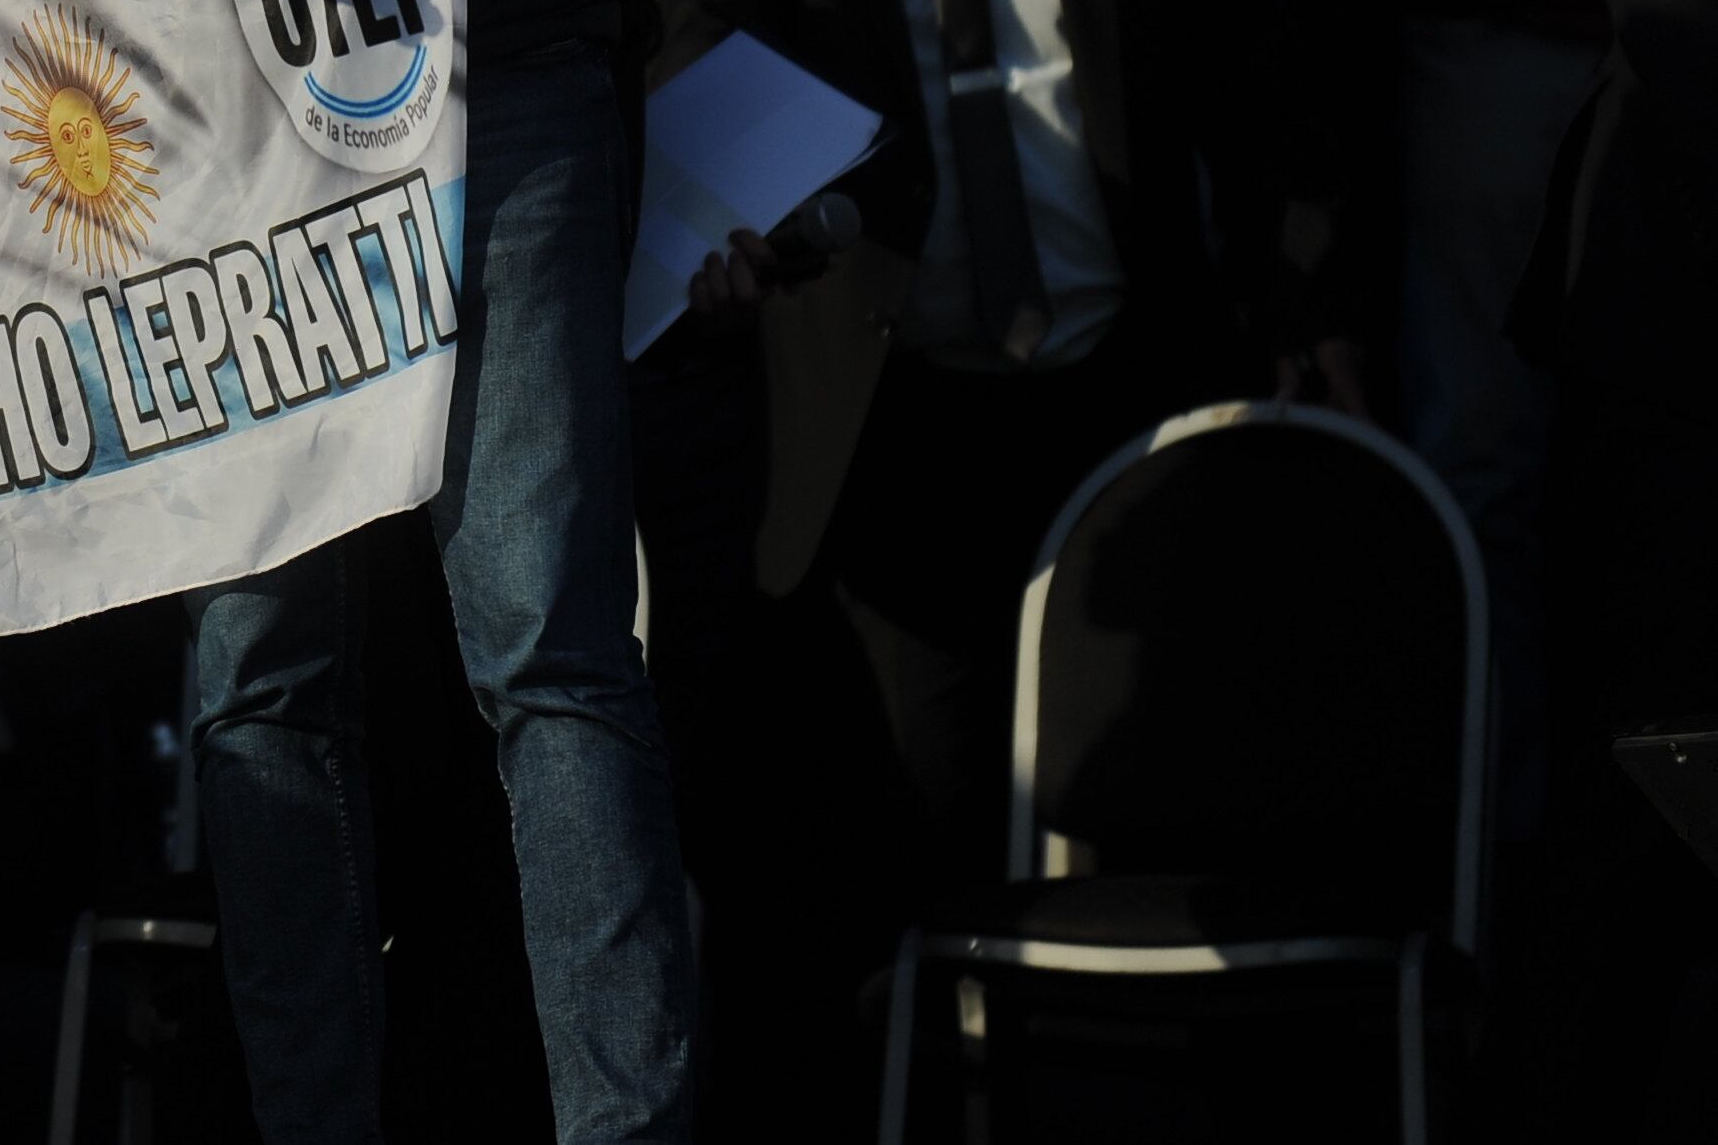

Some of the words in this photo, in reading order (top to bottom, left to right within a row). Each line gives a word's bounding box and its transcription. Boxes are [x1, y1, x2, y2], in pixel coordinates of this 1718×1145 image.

[304, 106, 323, 132] de
[326, 116, 340, 143] la
[343, 113, 410, 150] Economía
[405, 64, 439, 128] Popular
[83, 167, 461, 458] LEPRATTI
